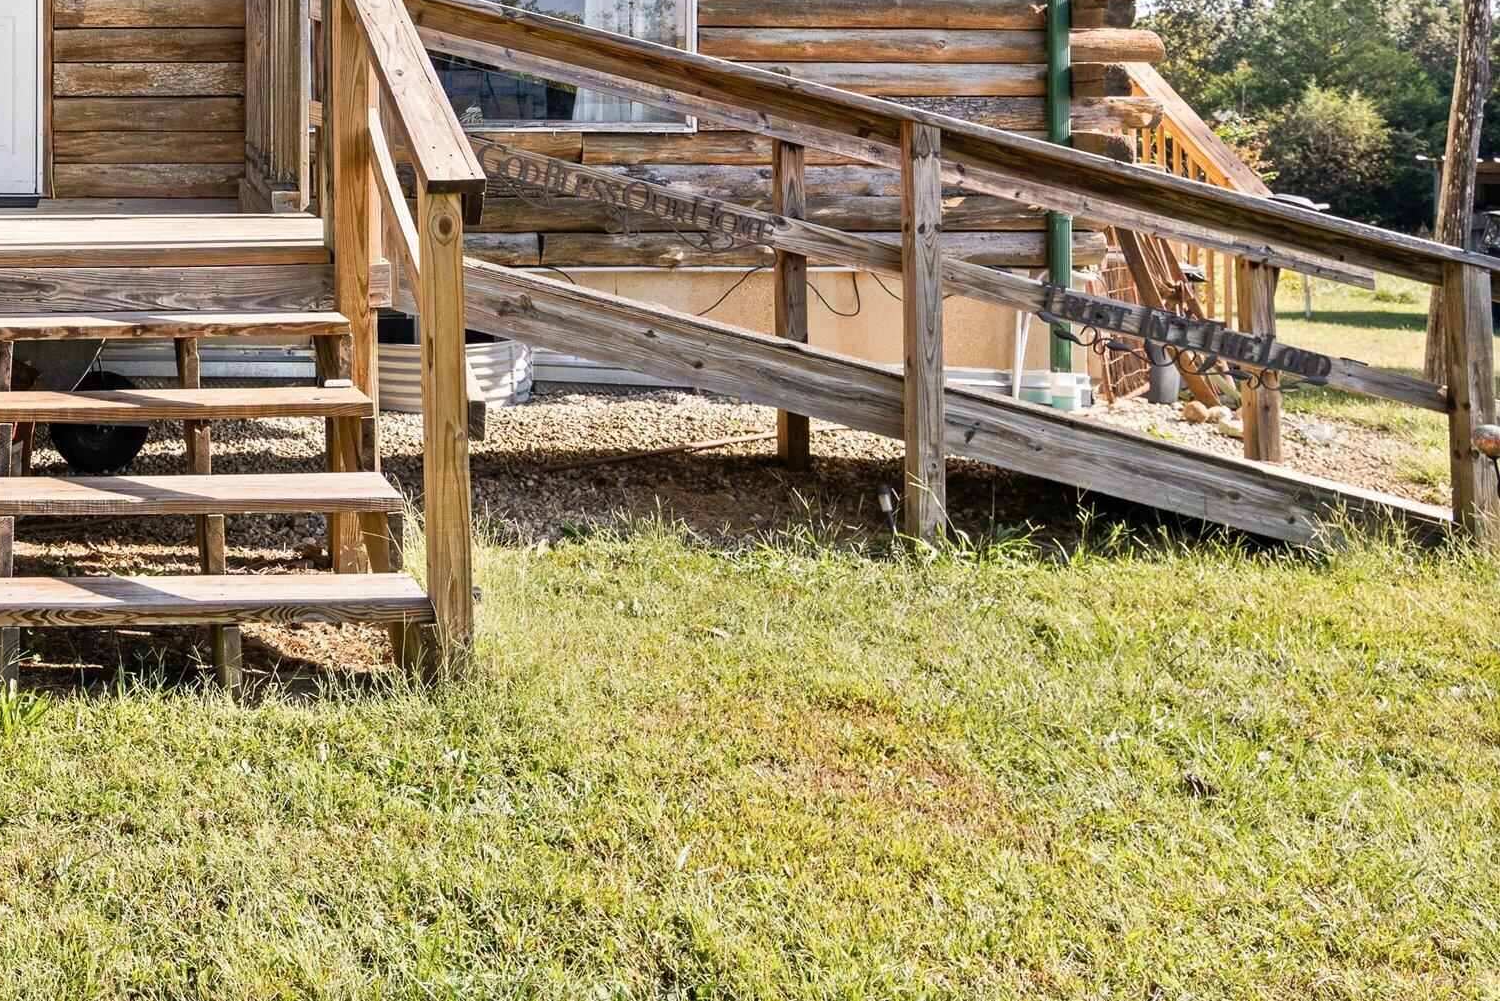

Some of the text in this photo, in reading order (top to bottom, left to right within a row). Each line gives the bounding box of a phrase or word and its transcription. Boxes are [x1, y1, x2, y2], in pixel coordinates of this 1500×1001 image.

[478, 143, 776, 245] GOD BLESS OUR HOME
[1041, 282, 1332, 378] TRUST IN THE LORD
